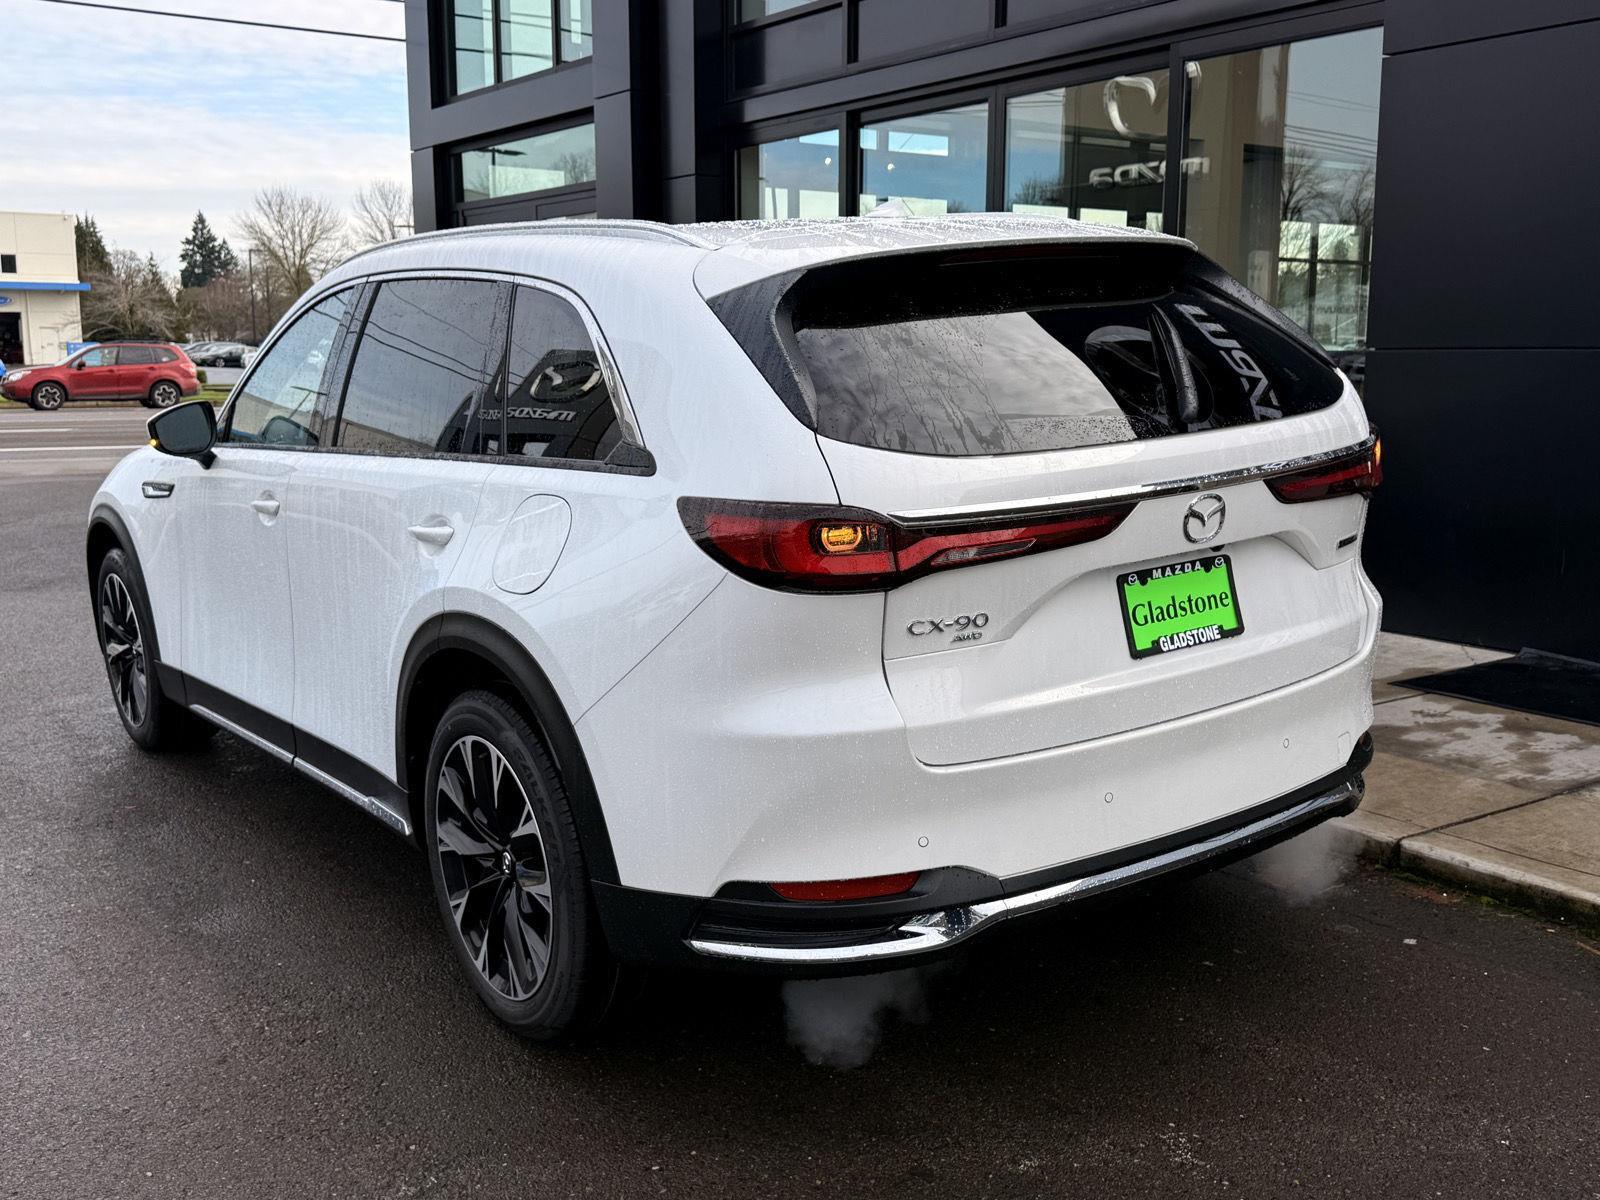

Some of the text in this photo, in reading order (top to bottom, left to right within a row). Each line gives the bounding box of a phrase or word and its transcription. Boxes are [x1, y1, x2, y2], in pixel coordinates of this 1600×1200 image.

[1153, 560, 1203, 579] MAZDA
[1131, 590, 1231, 627] Gladstone
[907, 612, 989, 636] CX-90
[1159, 624, 1222, 652] GLADSTONE
